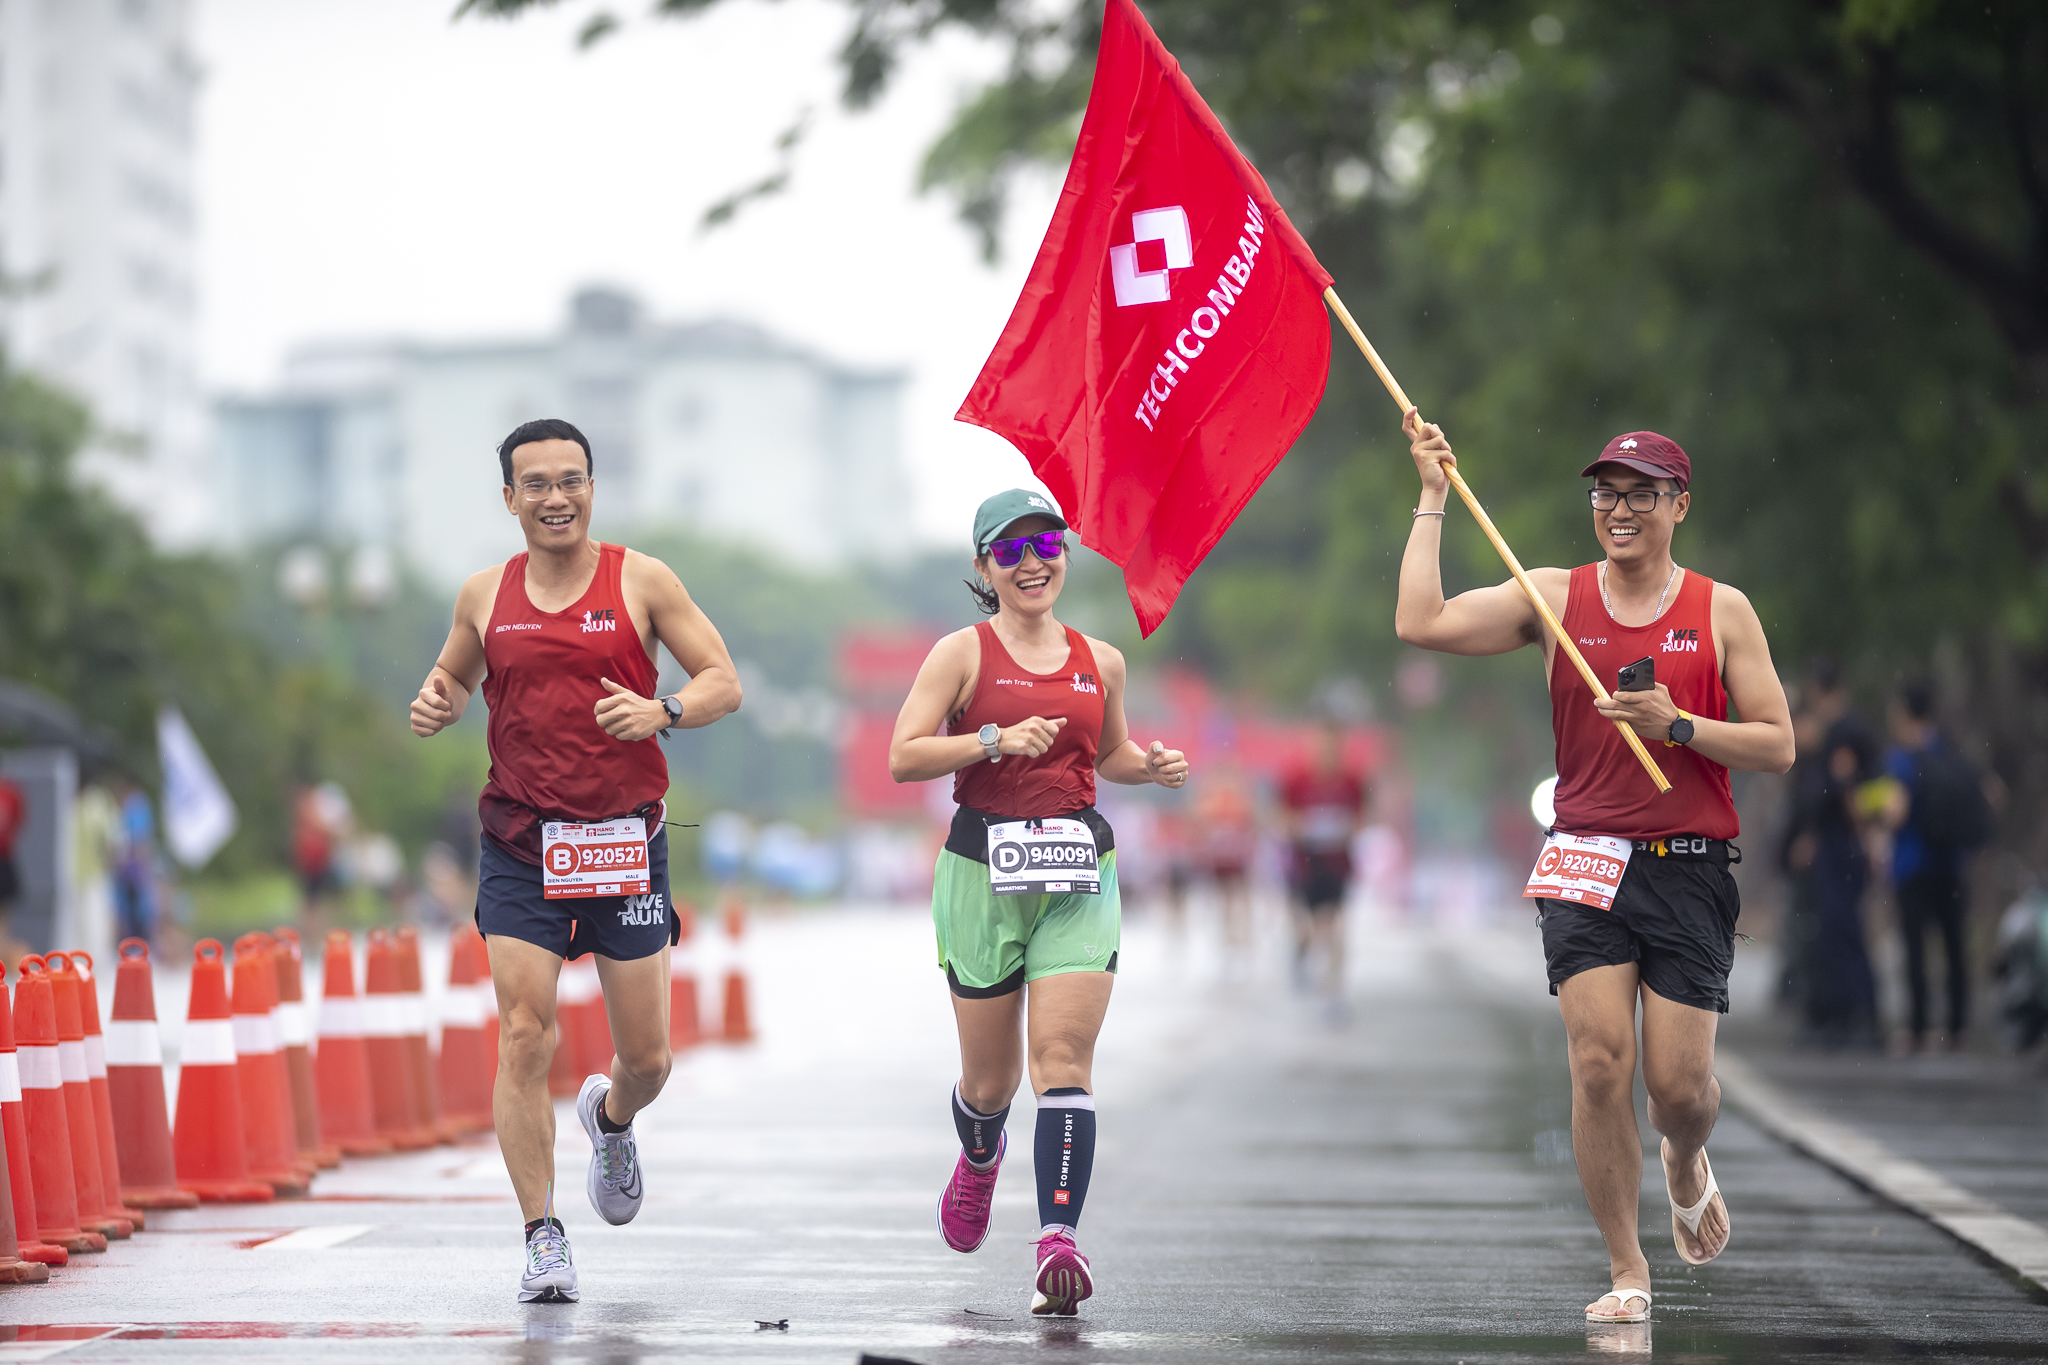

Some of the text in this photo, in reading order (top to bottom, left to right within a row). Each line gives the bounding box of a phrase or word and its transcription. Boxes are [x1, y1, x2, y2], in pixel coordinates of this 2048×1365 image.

[591, 609, 615, 620] WE
[495, 623, 542, 633] BIEN NGUYEN
[582, 620, 616, 633] RUN
[1579, 637, 1595, 646] Huy
[1673, 629, 1698, 641] WE
[1662, 640, 1698, 653] RUN
[1014, 679, 1033, 687] Trang
[1079, 673, 1095, 684] WE
[1072, 682, 1098, 695] RUN
[553, 846, 644, 870] B 920527
[999, 846, 1094, 868] D 940091
[1541, 852, 1620, 879] C 920138
[1590, 885, 1605, 893] MALE
[635, 893, 664, 909] WE
[621, 908, 665, 926] RUN
[1060, 1113, 1073, 1187] COMPRESSPORT
